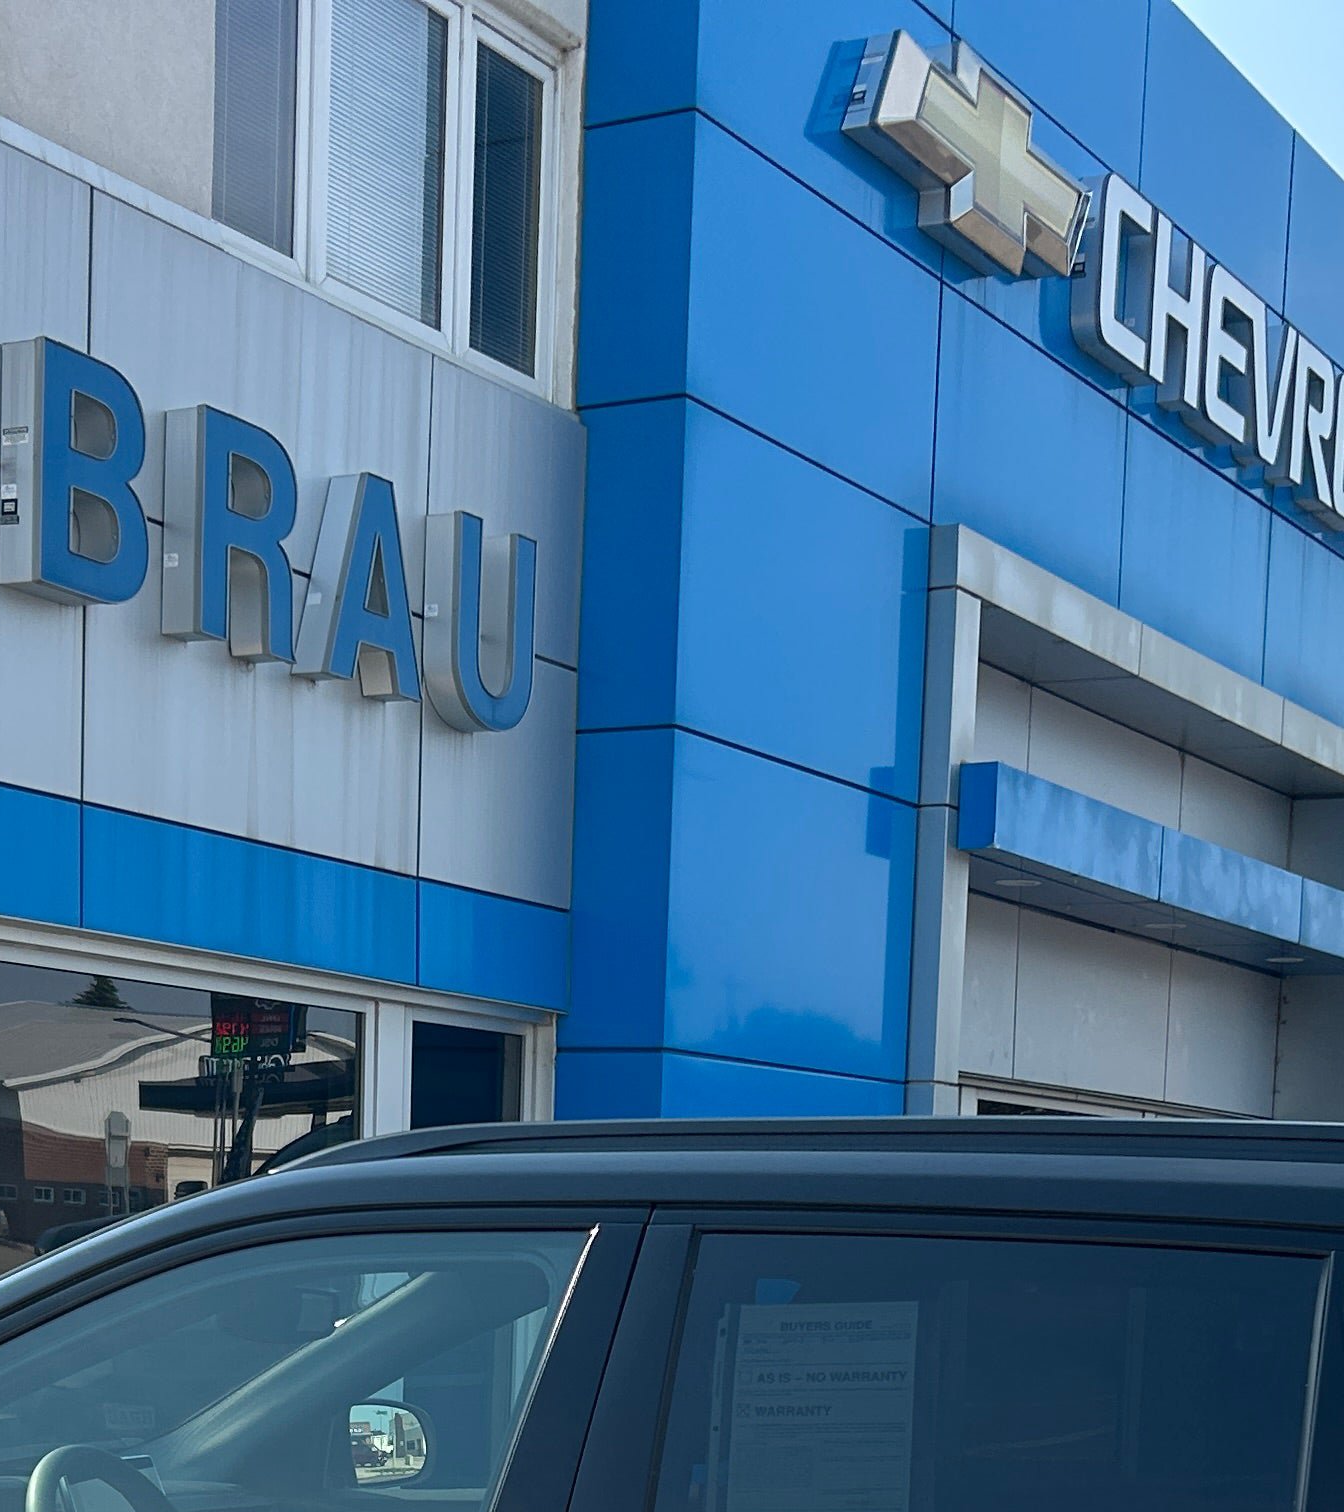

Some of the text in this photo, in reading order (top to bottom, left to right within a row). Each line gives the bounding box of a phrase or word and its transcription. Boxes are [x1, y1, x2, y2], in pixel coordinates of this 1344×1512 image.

[26, 335, 537, 734] BRAU
[780, 1319, 873, 1332] BUYERS GUIDE
[830, 1370, 907, 1383] WARRANTY
[754, 1405, 833, 1417] WARRANTY
